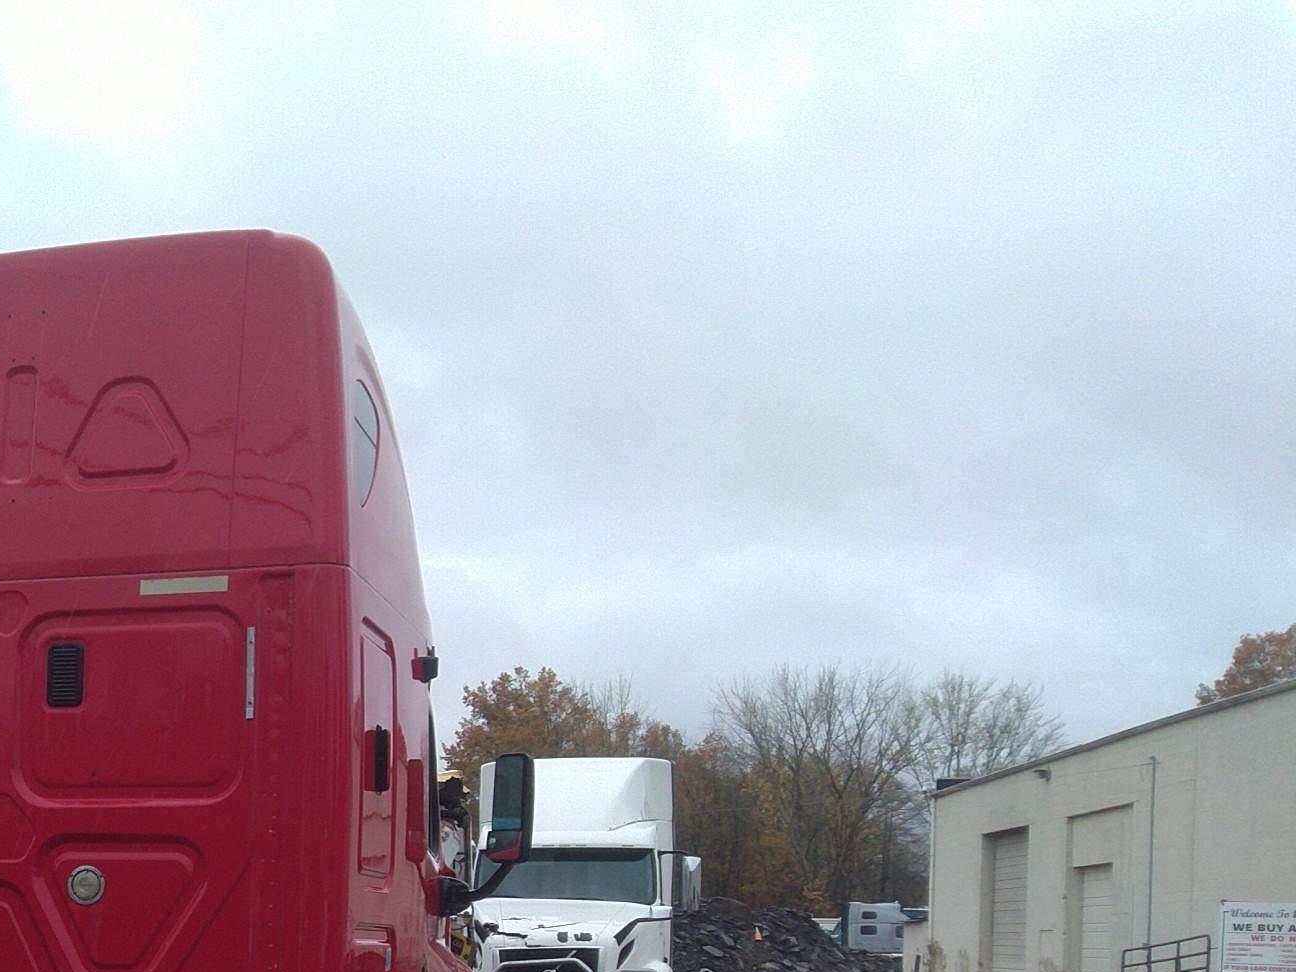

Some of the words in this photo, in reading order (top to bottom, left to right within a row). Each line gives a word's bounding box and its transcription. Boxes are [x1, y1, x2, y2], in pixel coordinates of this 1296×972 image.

[1231, 909, 1273, 918] Welcome
[1233, 923, 1253, 931] WE
[1257, 924, 1284, 932] BUY
